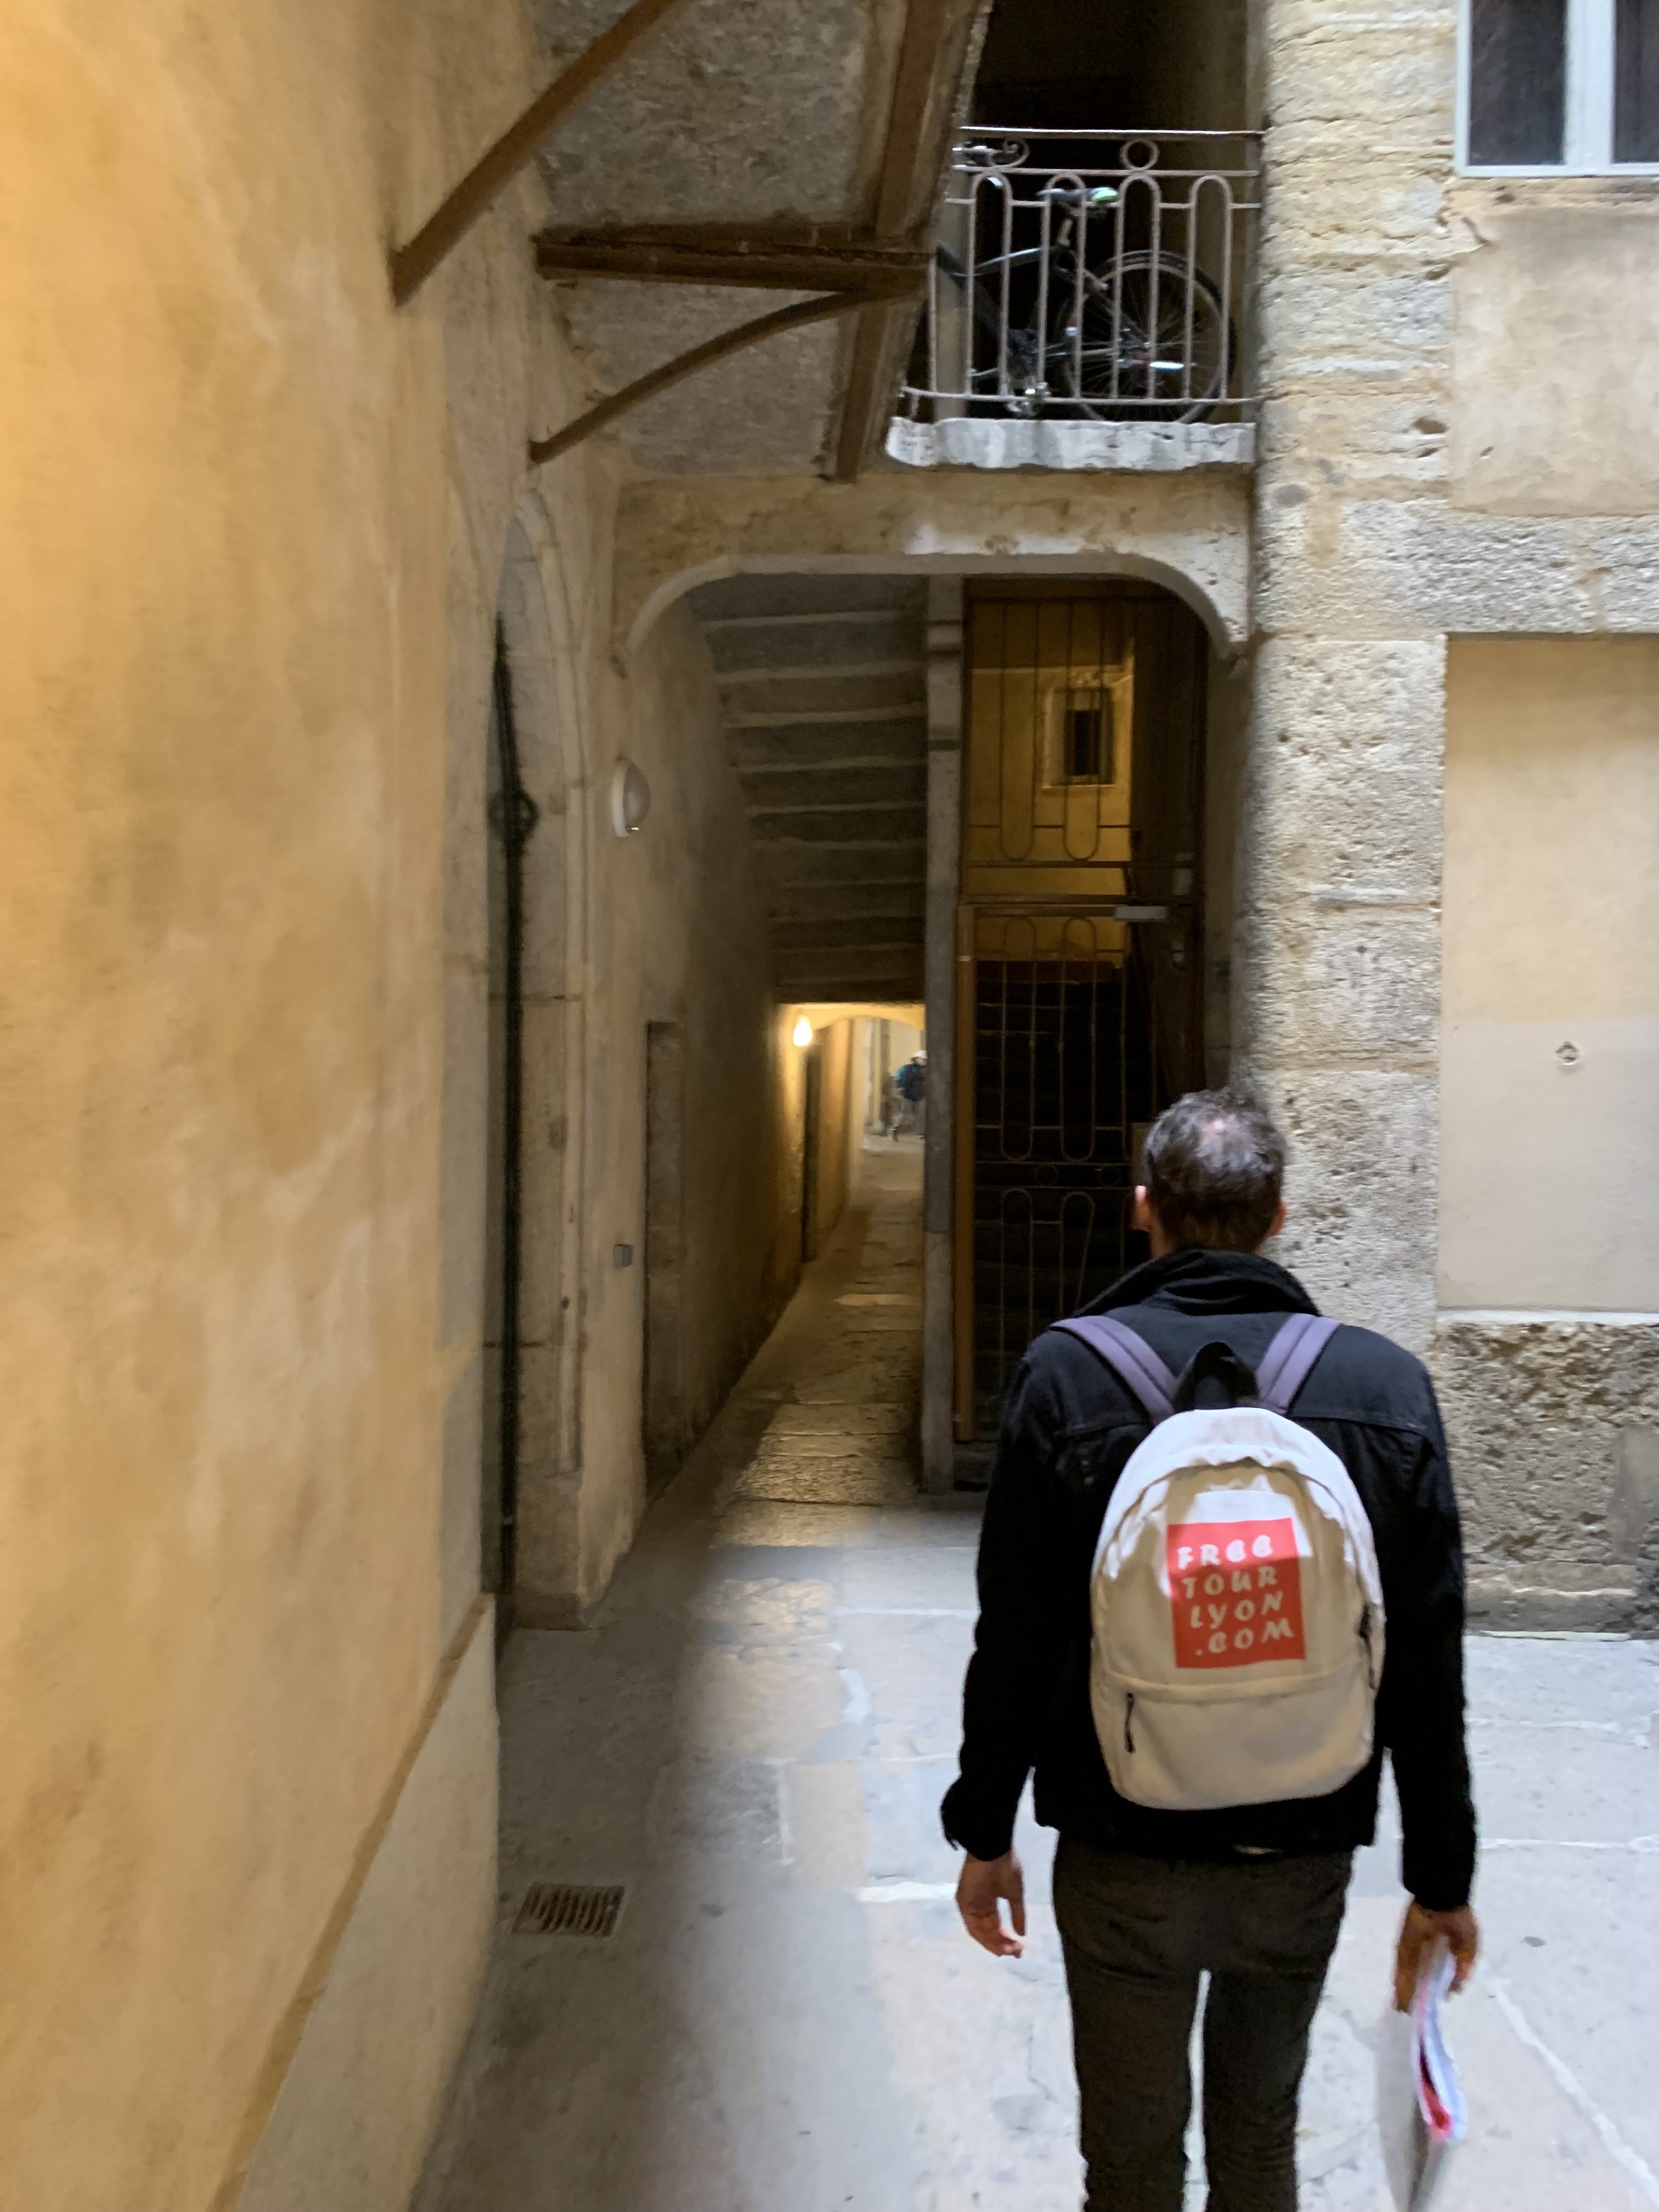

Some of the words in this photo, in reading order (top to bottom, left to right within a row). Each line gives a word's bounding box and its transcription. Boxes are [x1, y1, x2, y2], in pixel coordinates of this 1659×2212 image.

[1177, 1535, 1273, 1570] FREE
[1182, 1566, 1277, 1599] TOUR
[1195, 1618, 1294, 1656] .COM
